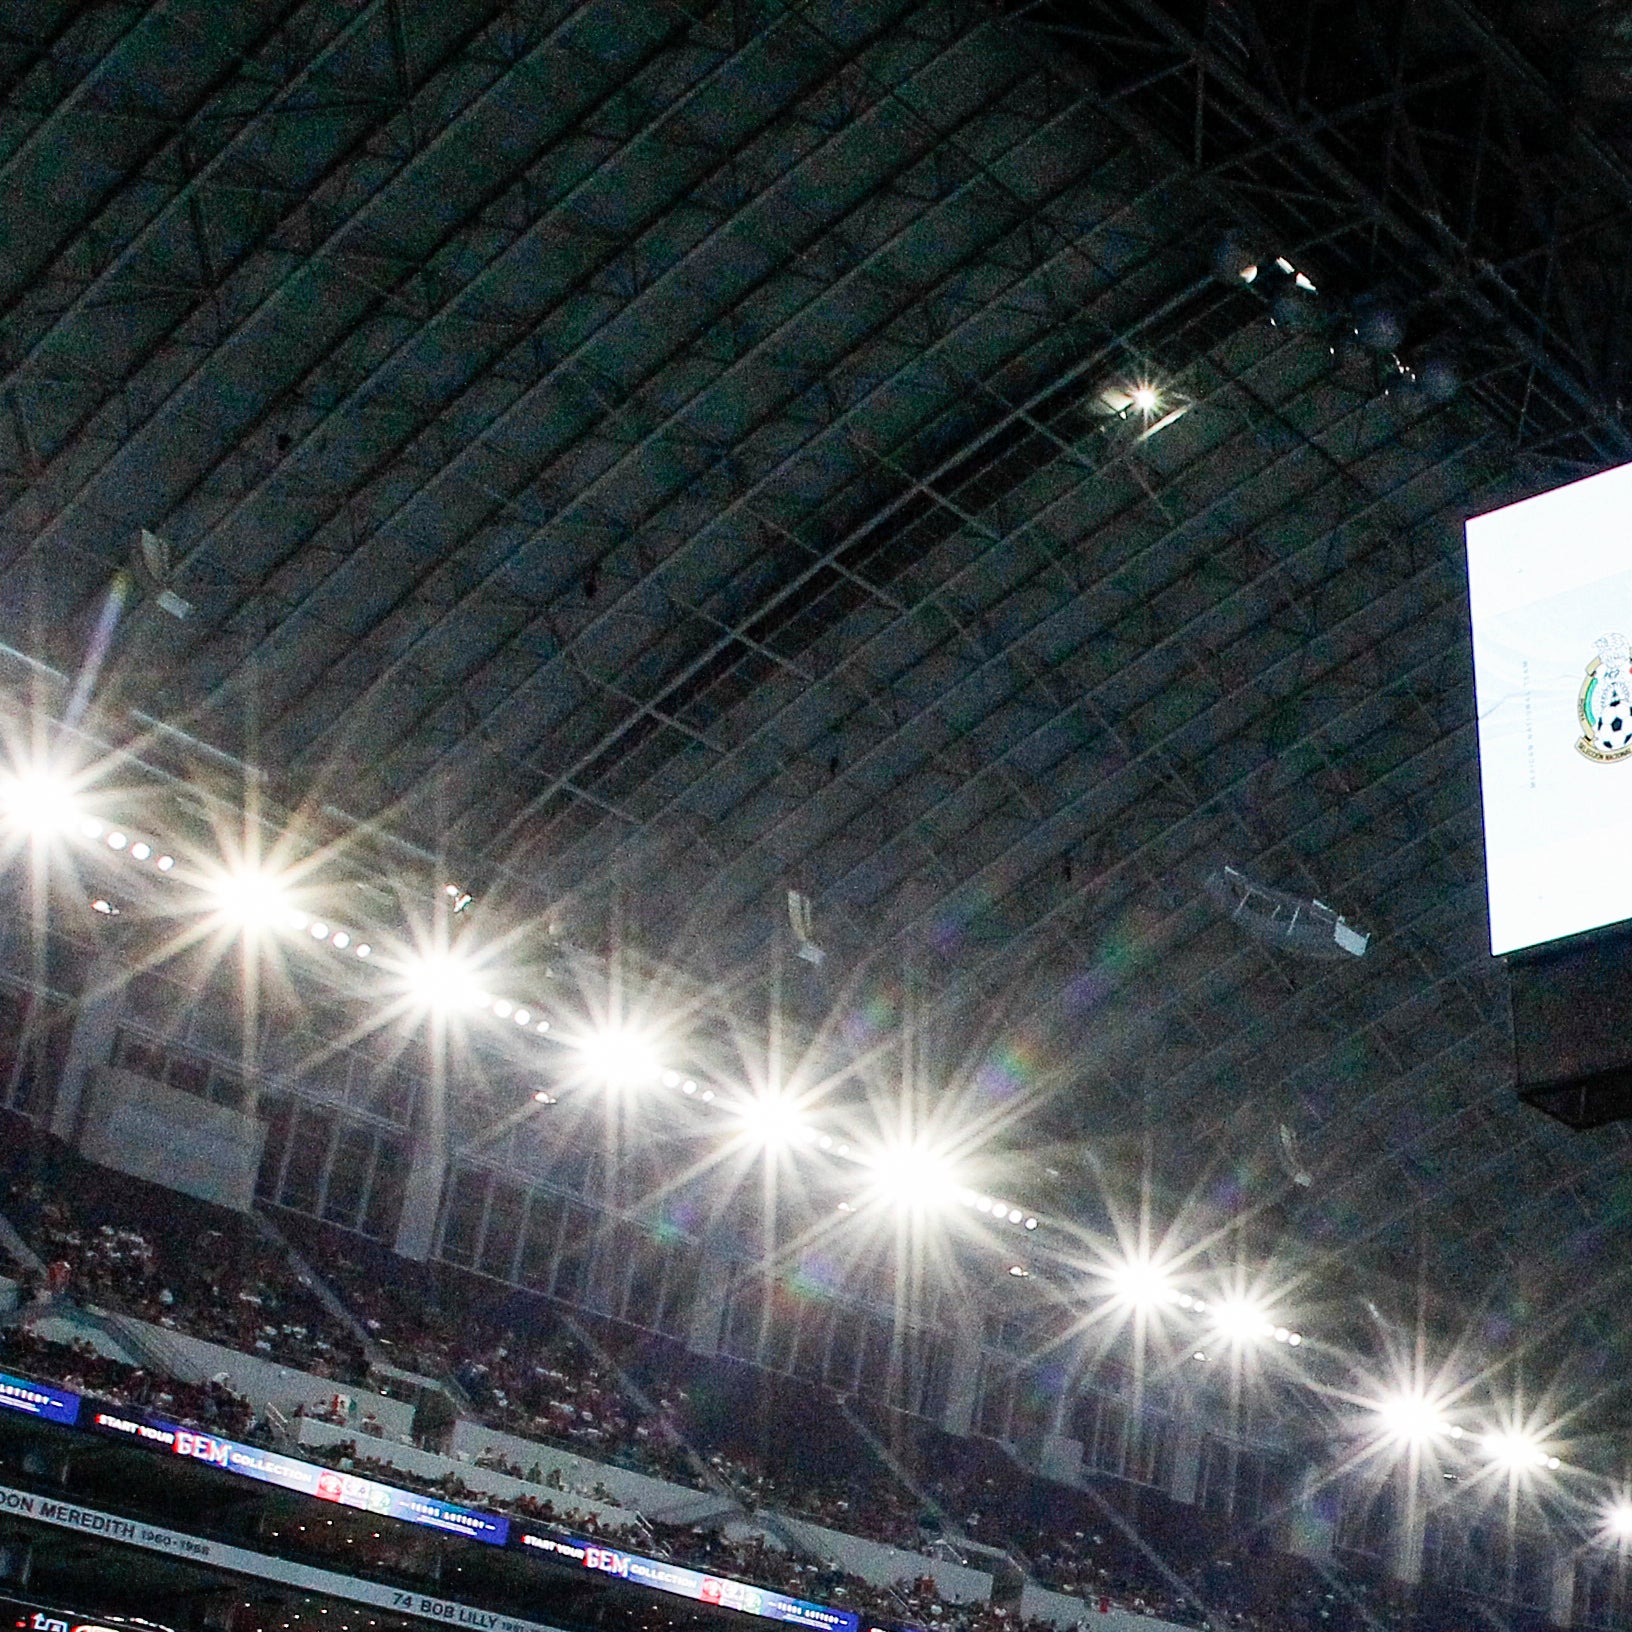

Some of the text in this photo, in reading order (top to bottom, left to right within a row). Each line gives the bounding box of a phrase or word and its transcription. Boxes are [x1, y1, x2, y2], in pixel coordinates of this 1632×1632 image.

[95, 1414, 313, 1484] START YOUR GEM COLLECTION
[39, 1502, 136, 1538] MEREDITH
[521, 1534, 697, 1588] START YOUR GEM COLLECTION
[391, 1592, 498, 1629] 74 BOB LILLY
